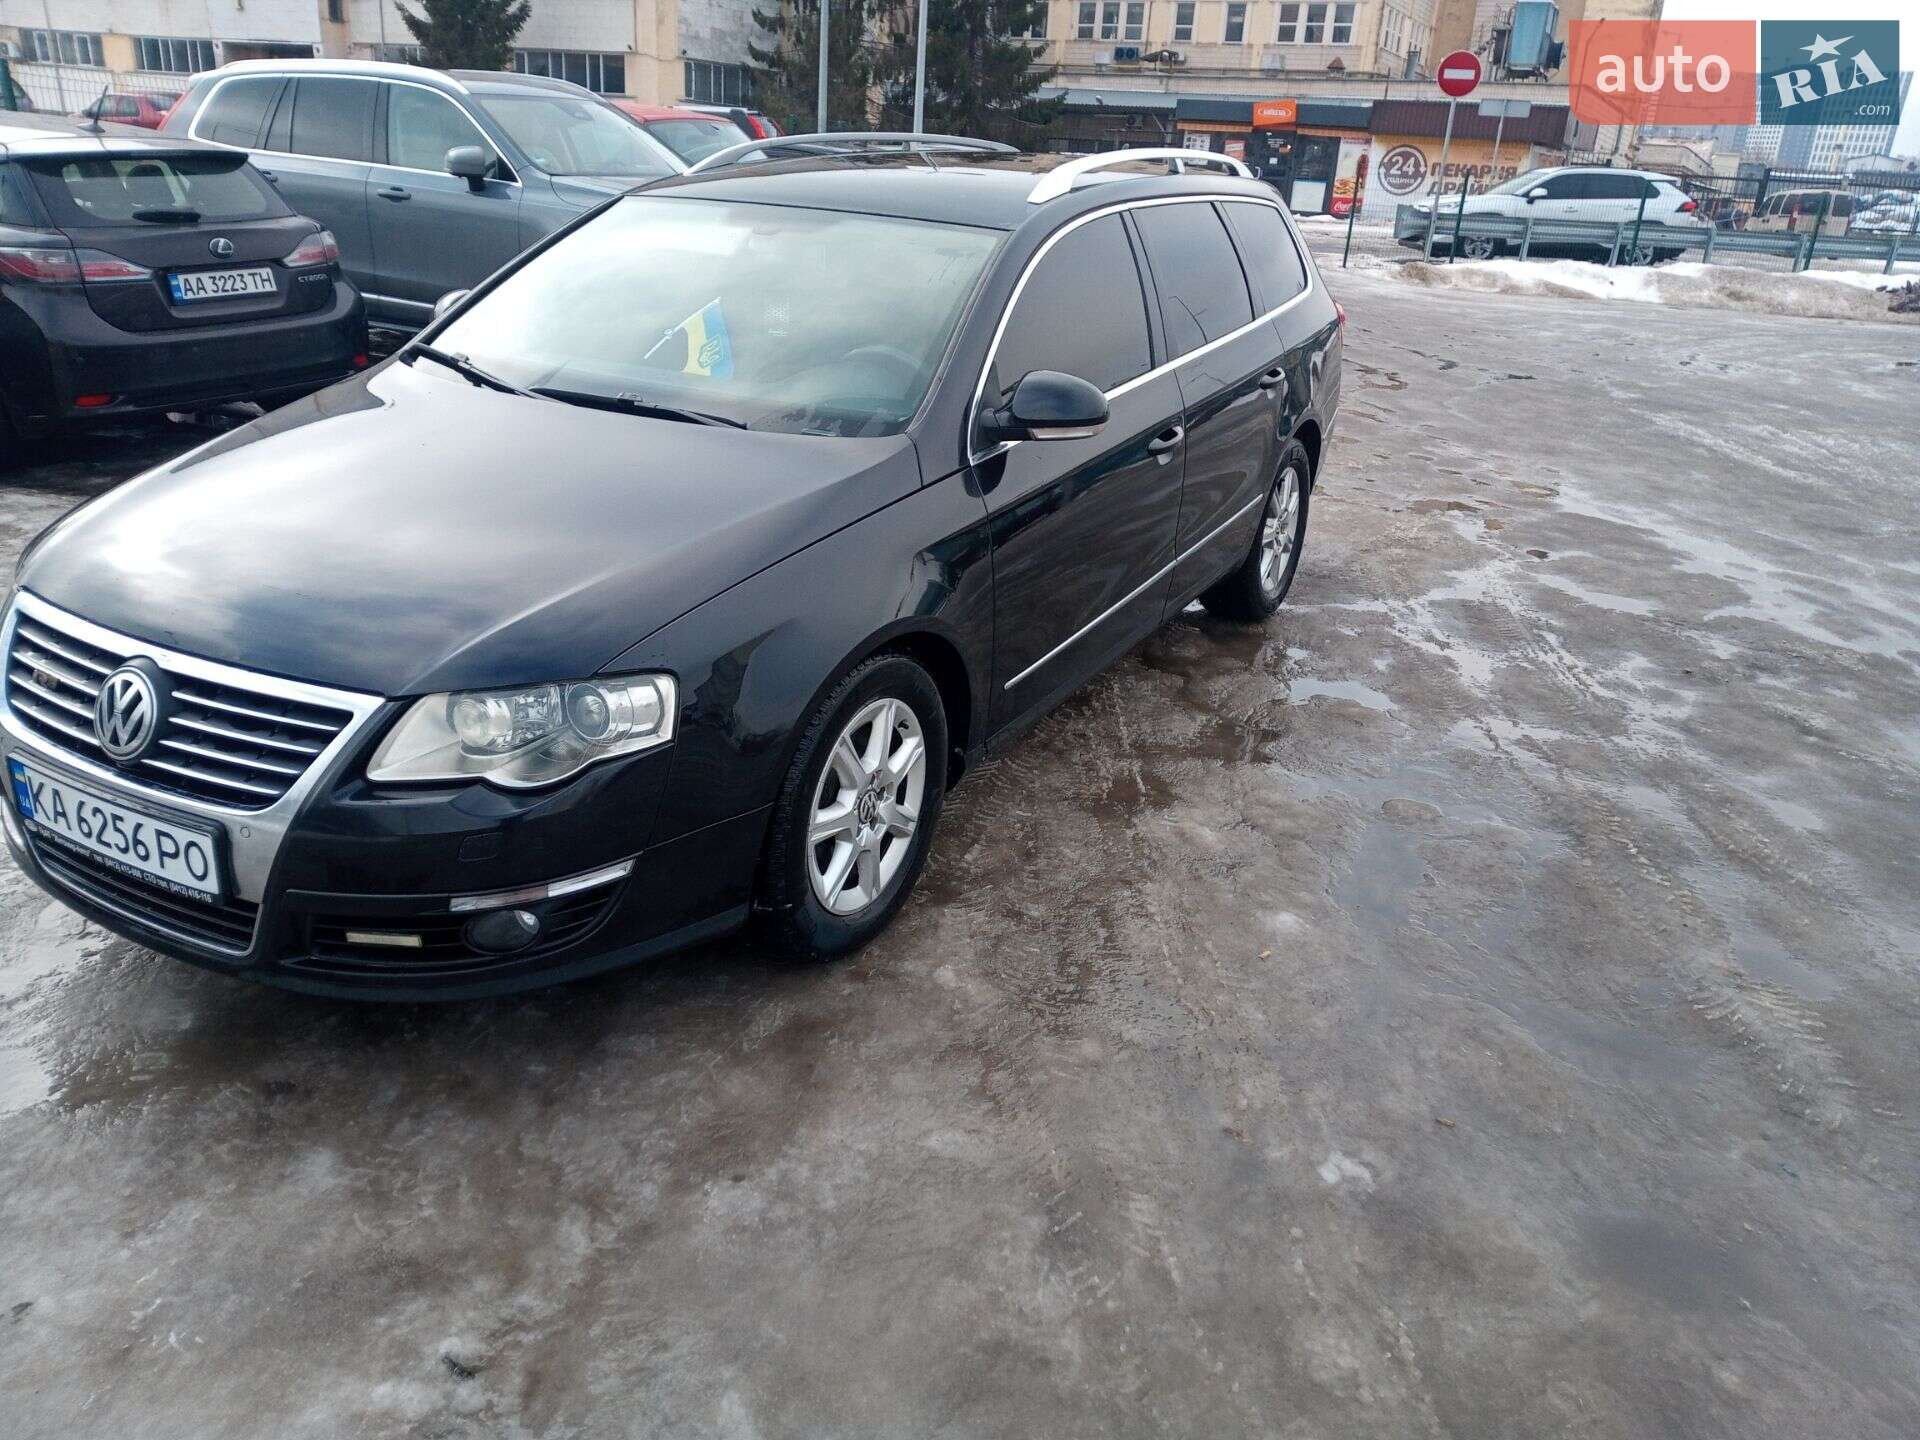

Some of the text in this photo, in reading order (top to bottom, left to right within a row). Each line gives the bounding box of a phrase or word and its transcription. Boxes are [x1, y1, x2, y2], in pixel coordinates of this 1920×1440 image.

[1390, 156, 1415, 175] 24
[1427, 180, 1496, 197] ДРАЙ
[183, 271, 273, 297] AA 3223 TH
[26, 775, 72, 831] KA
[76, 800, 150, 862] 6256
[154, 828, 209, 882] PO
